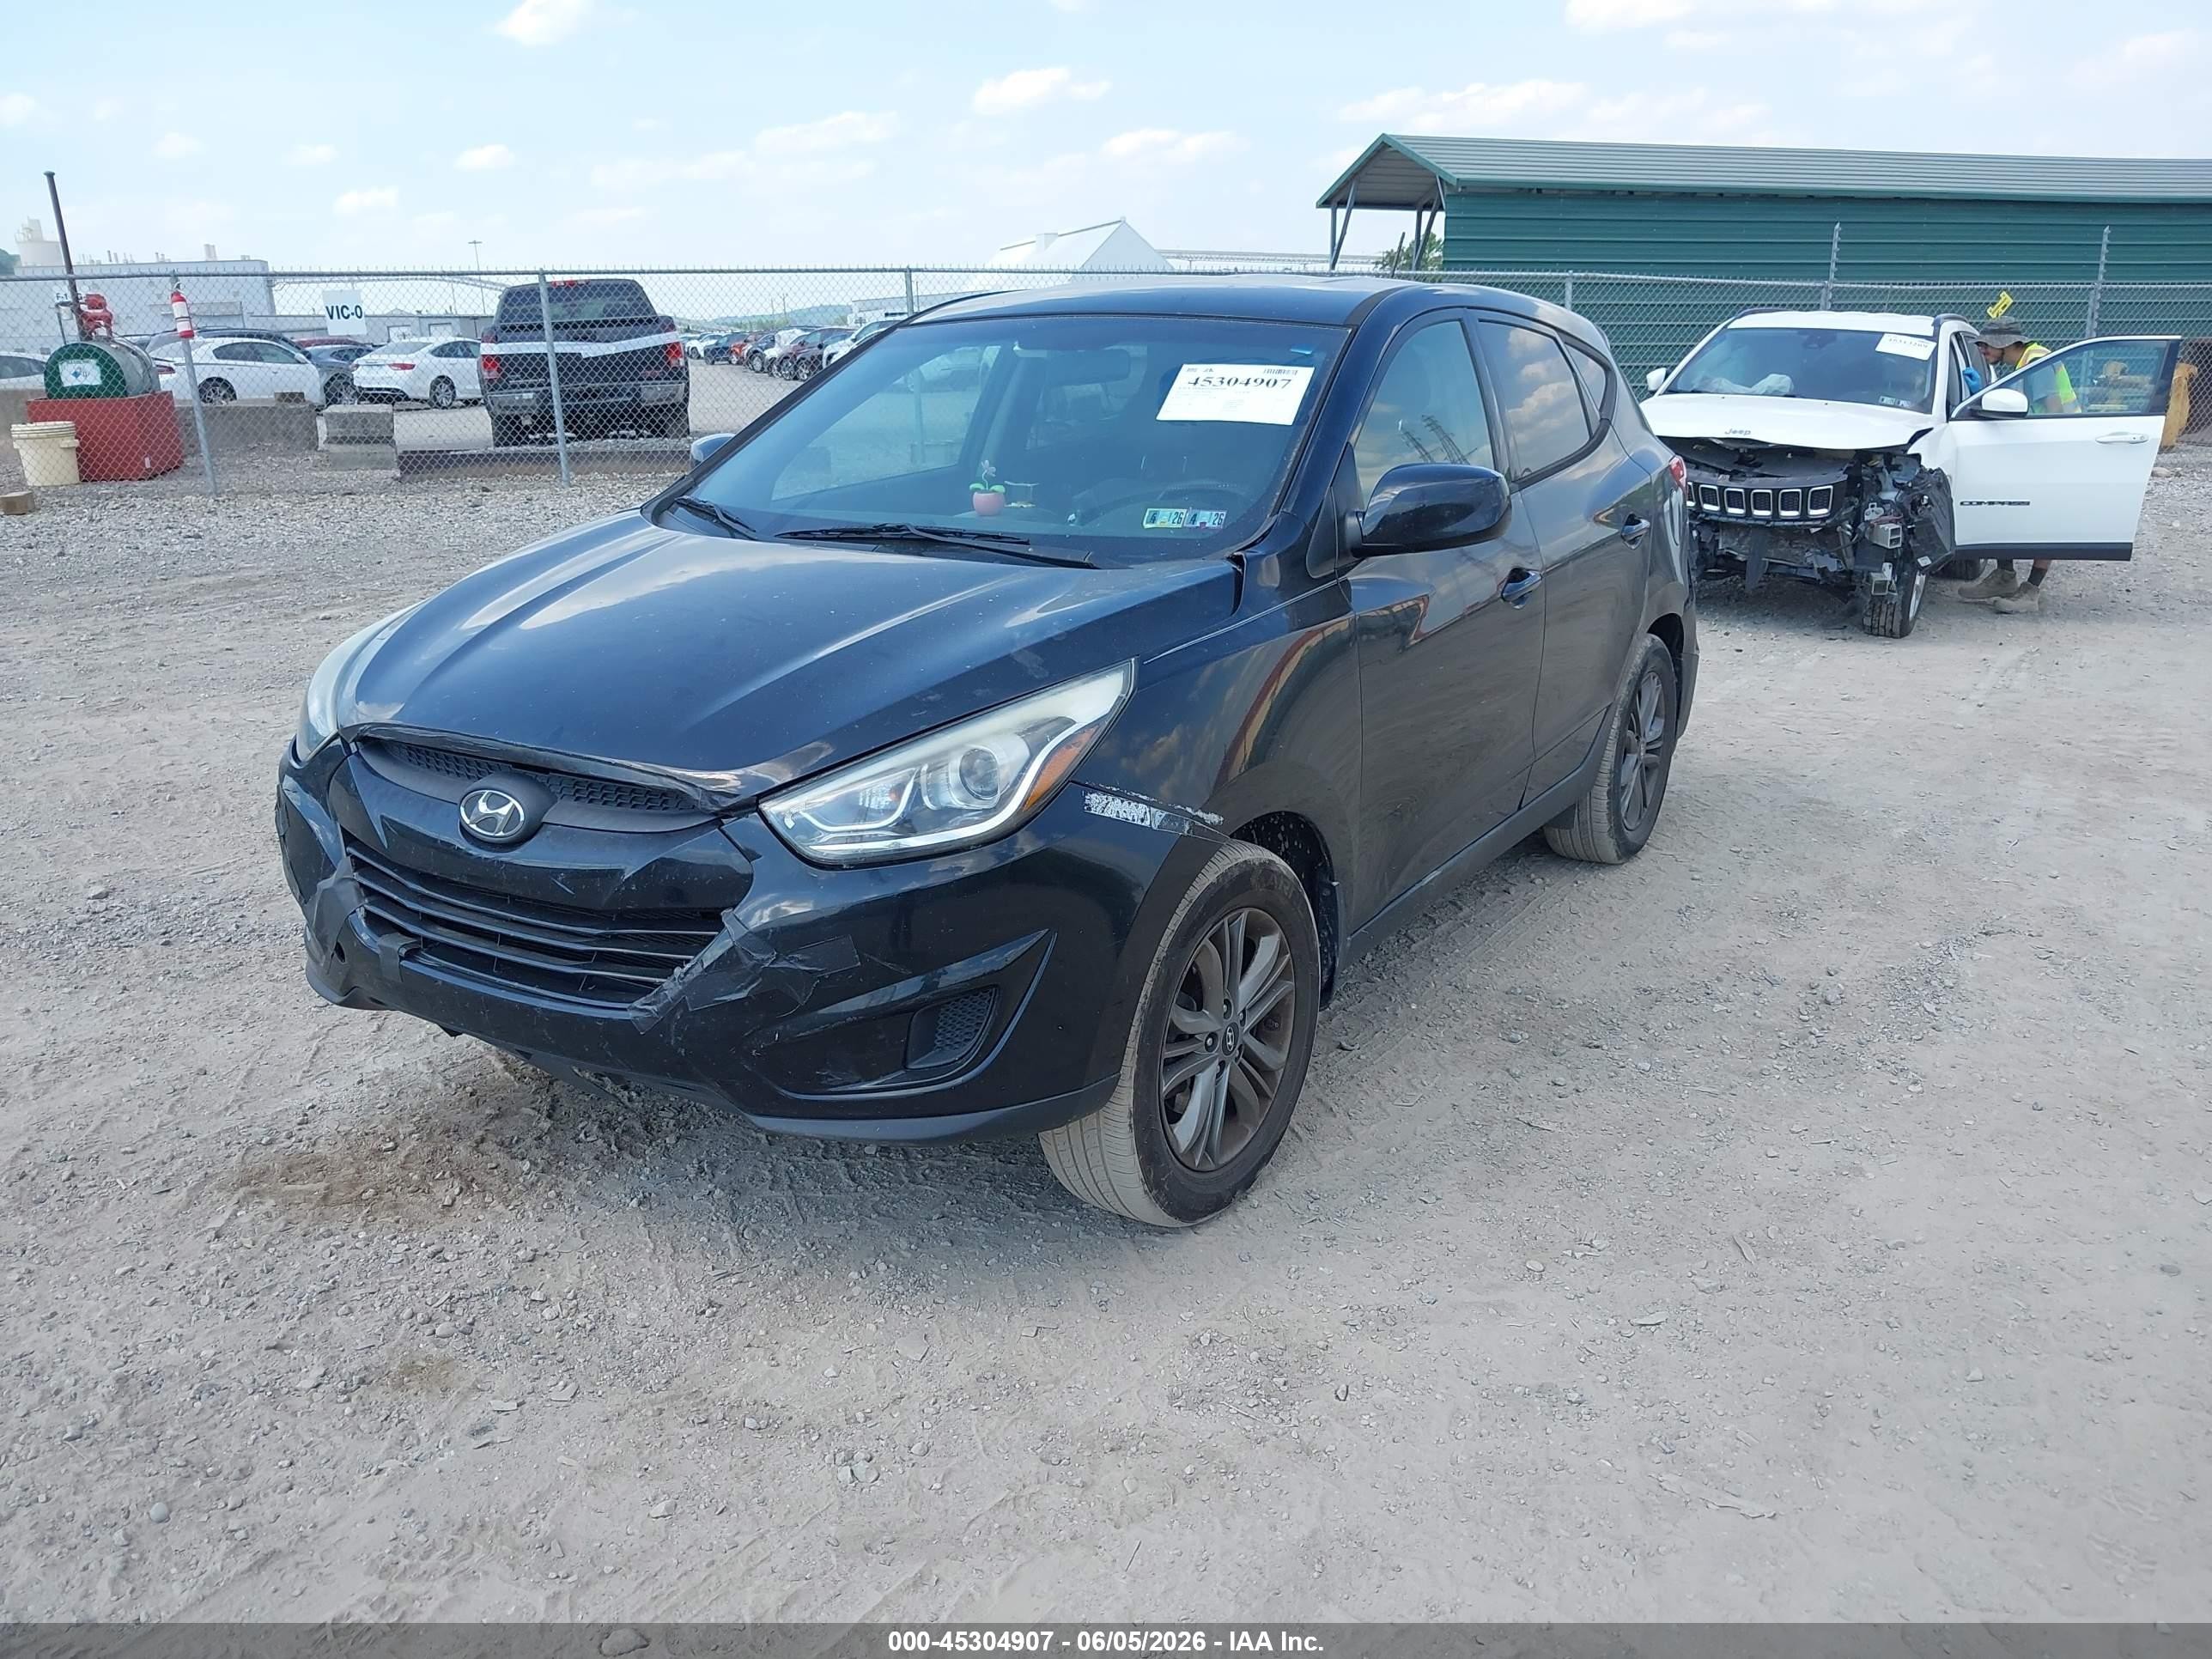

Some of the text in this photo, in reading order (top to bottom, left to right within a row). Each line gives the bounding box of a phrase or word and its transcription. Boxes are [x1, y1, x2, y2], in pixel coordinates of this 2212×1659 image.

[325, 305, 362, 319] VIC-0
[1188, 376, 1292, 389] 45304907
[1724, 428, 1751, 436] Jeep
